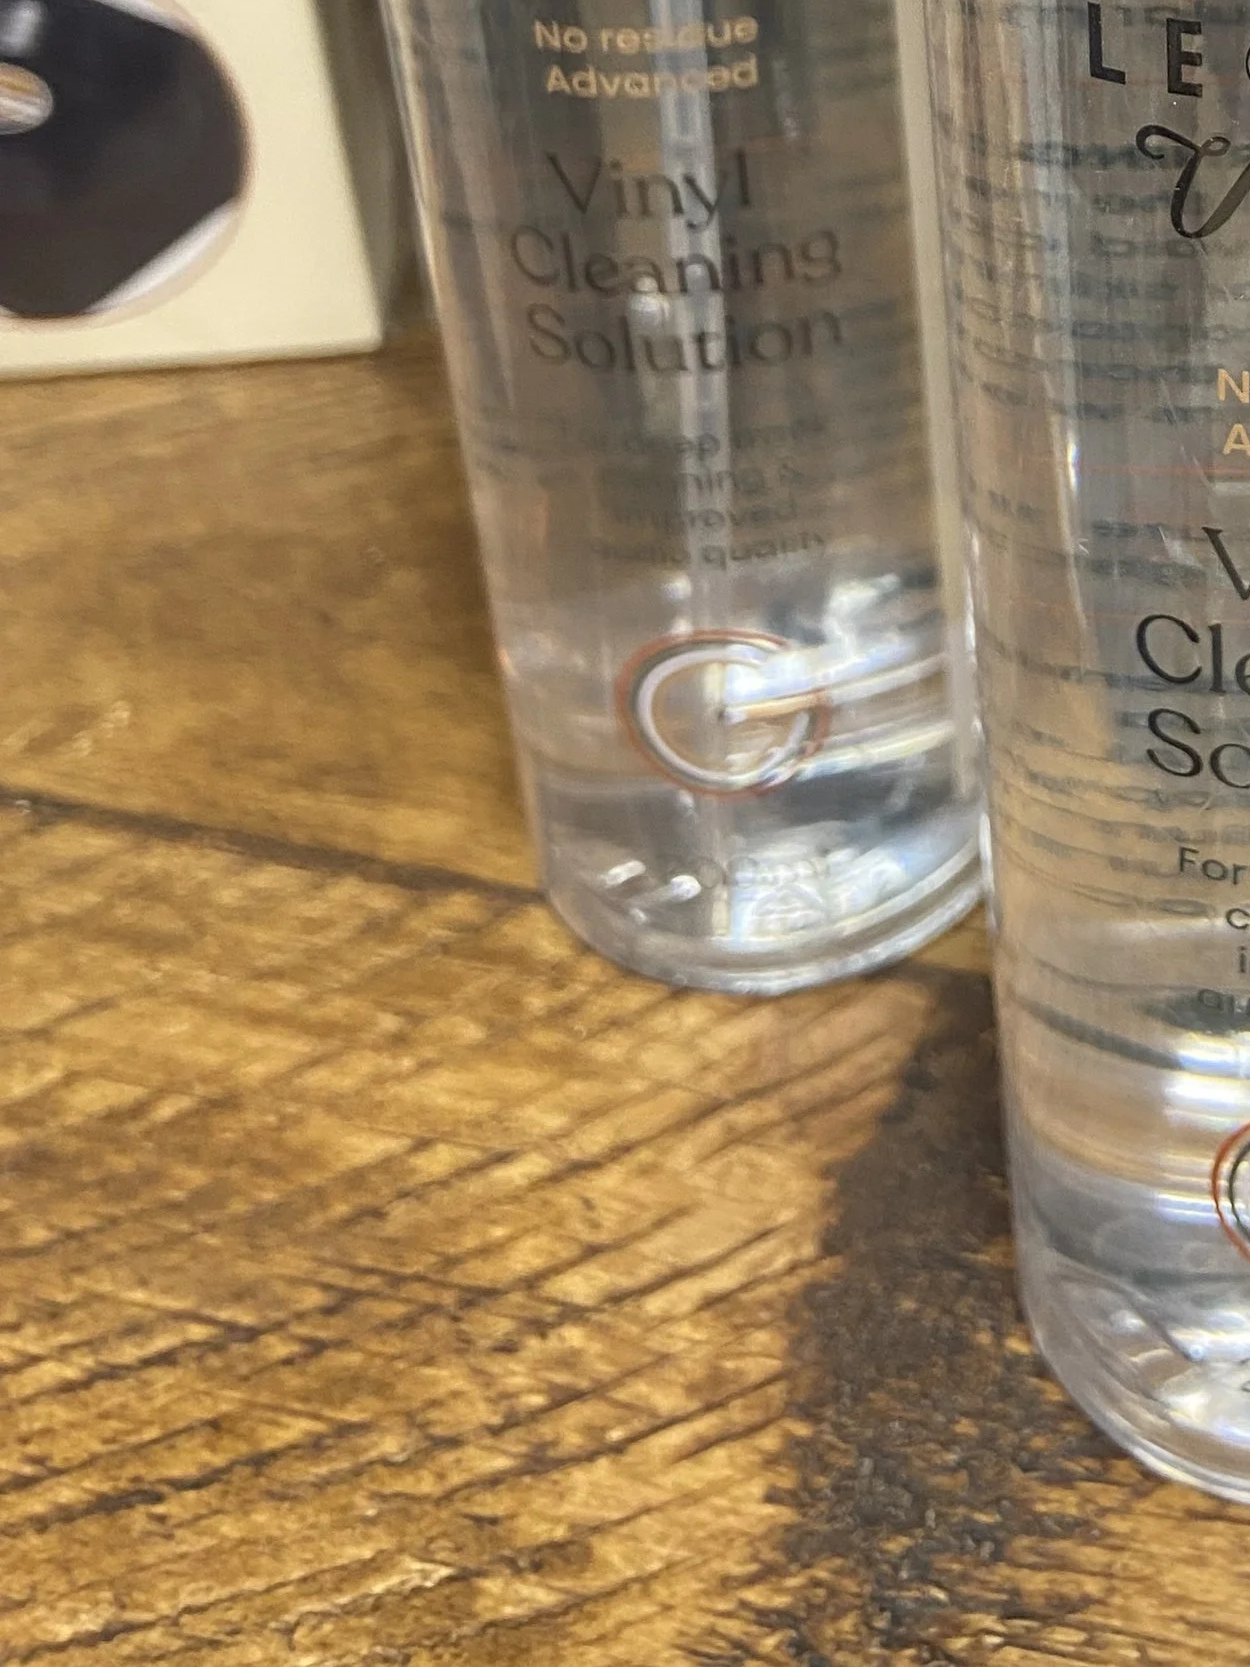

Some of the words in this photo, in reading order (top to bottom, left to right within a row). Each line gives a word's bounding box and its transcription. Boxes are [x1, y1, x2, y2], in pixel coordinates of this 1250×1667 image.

[533, 17, 588, 55] No
[600, 14, 760, 56] residue
[545, 52, 760, 99] Advanced
[546, 149, 751, 232] Vinyl
[510, 224, 843, 296] Cleaning
[526, 302, 842, 372] Solution
[1177, 845, 1246, 886] For
